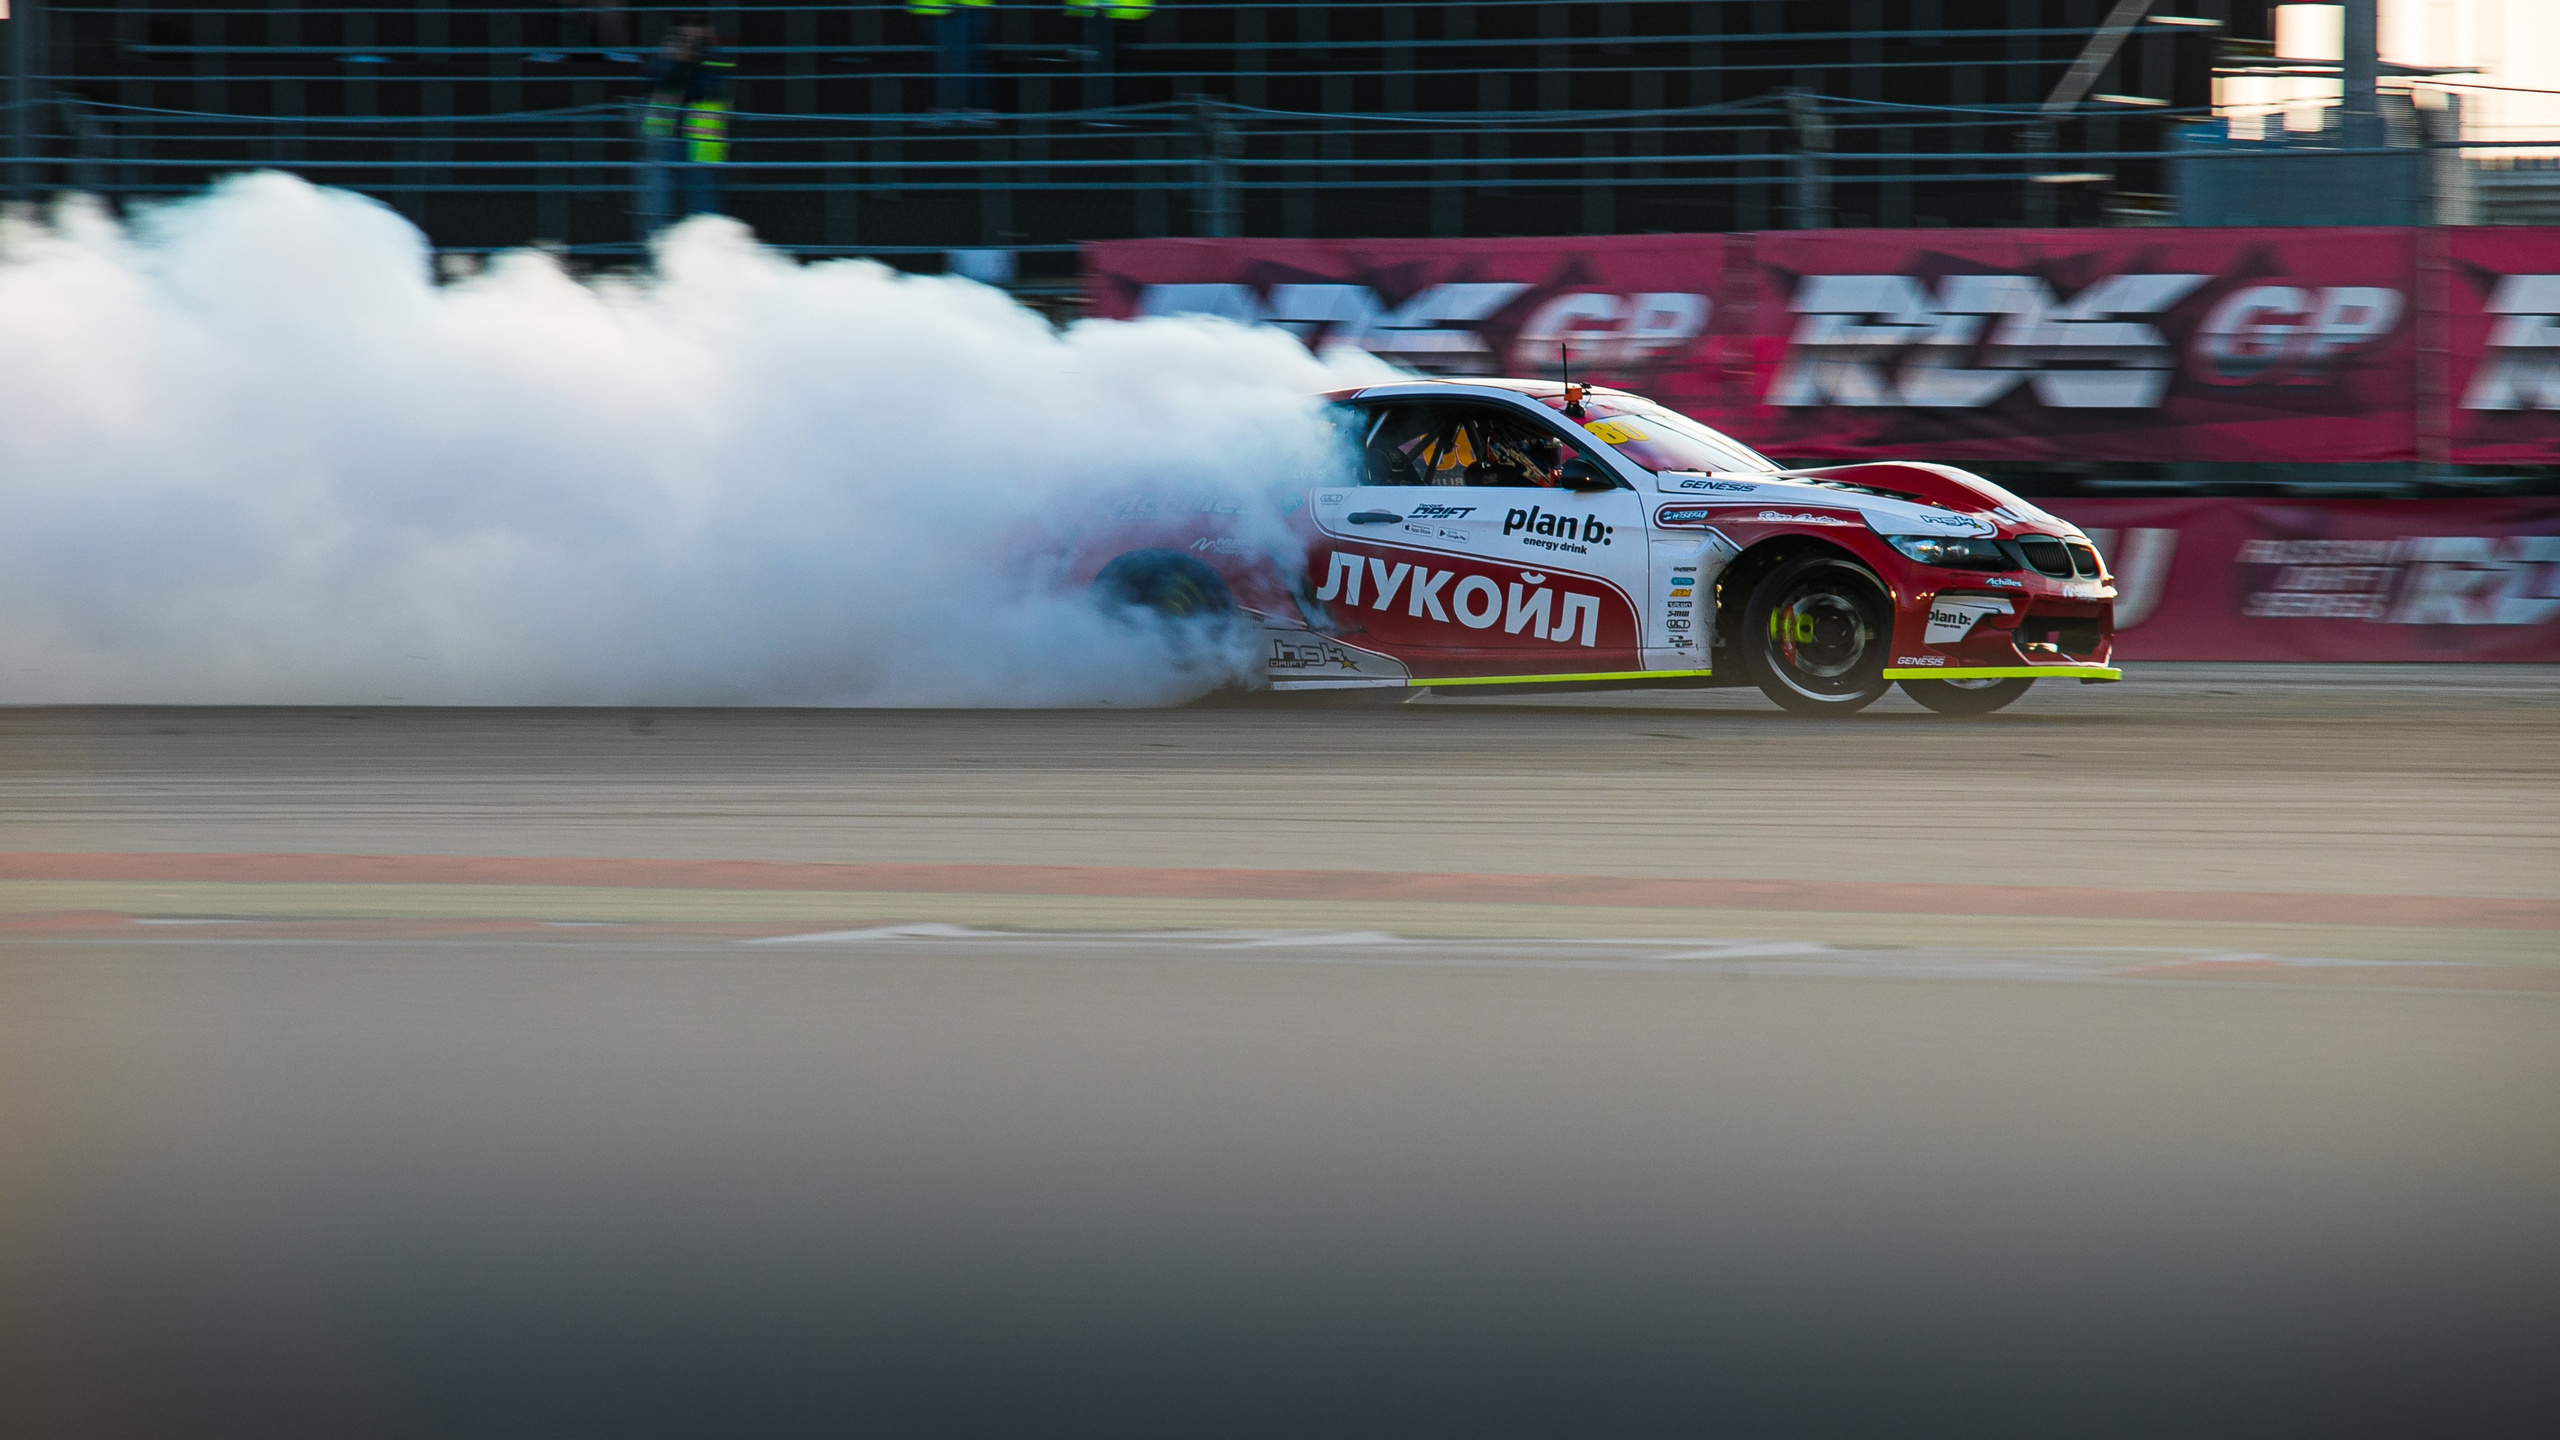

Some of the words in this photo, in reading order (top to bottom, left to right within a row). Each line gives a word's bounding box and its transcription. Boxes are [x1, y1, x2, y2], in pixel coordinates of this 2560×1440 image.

[1765, 275, 2210, 408] RDS
[2197, 286, 2405, 382] GP
[1584, 422, 1649, 444] 80
[1680, 480, 1757, 492] GENESIS
[1503, 505, 1578, 540] plan
[1582, 513, 1613, 546] b:
[1523, 536, 1559, 551] energy
[1560, 542, 1587, 555] drink
[1986, 577, 2022, 587] Achilles
[1316, 551, 1600, 648] ЛУКОЙЛ
[1273, 639, 1345, 667] hgk
[1897, 656, 1946, 666] GENESIS
